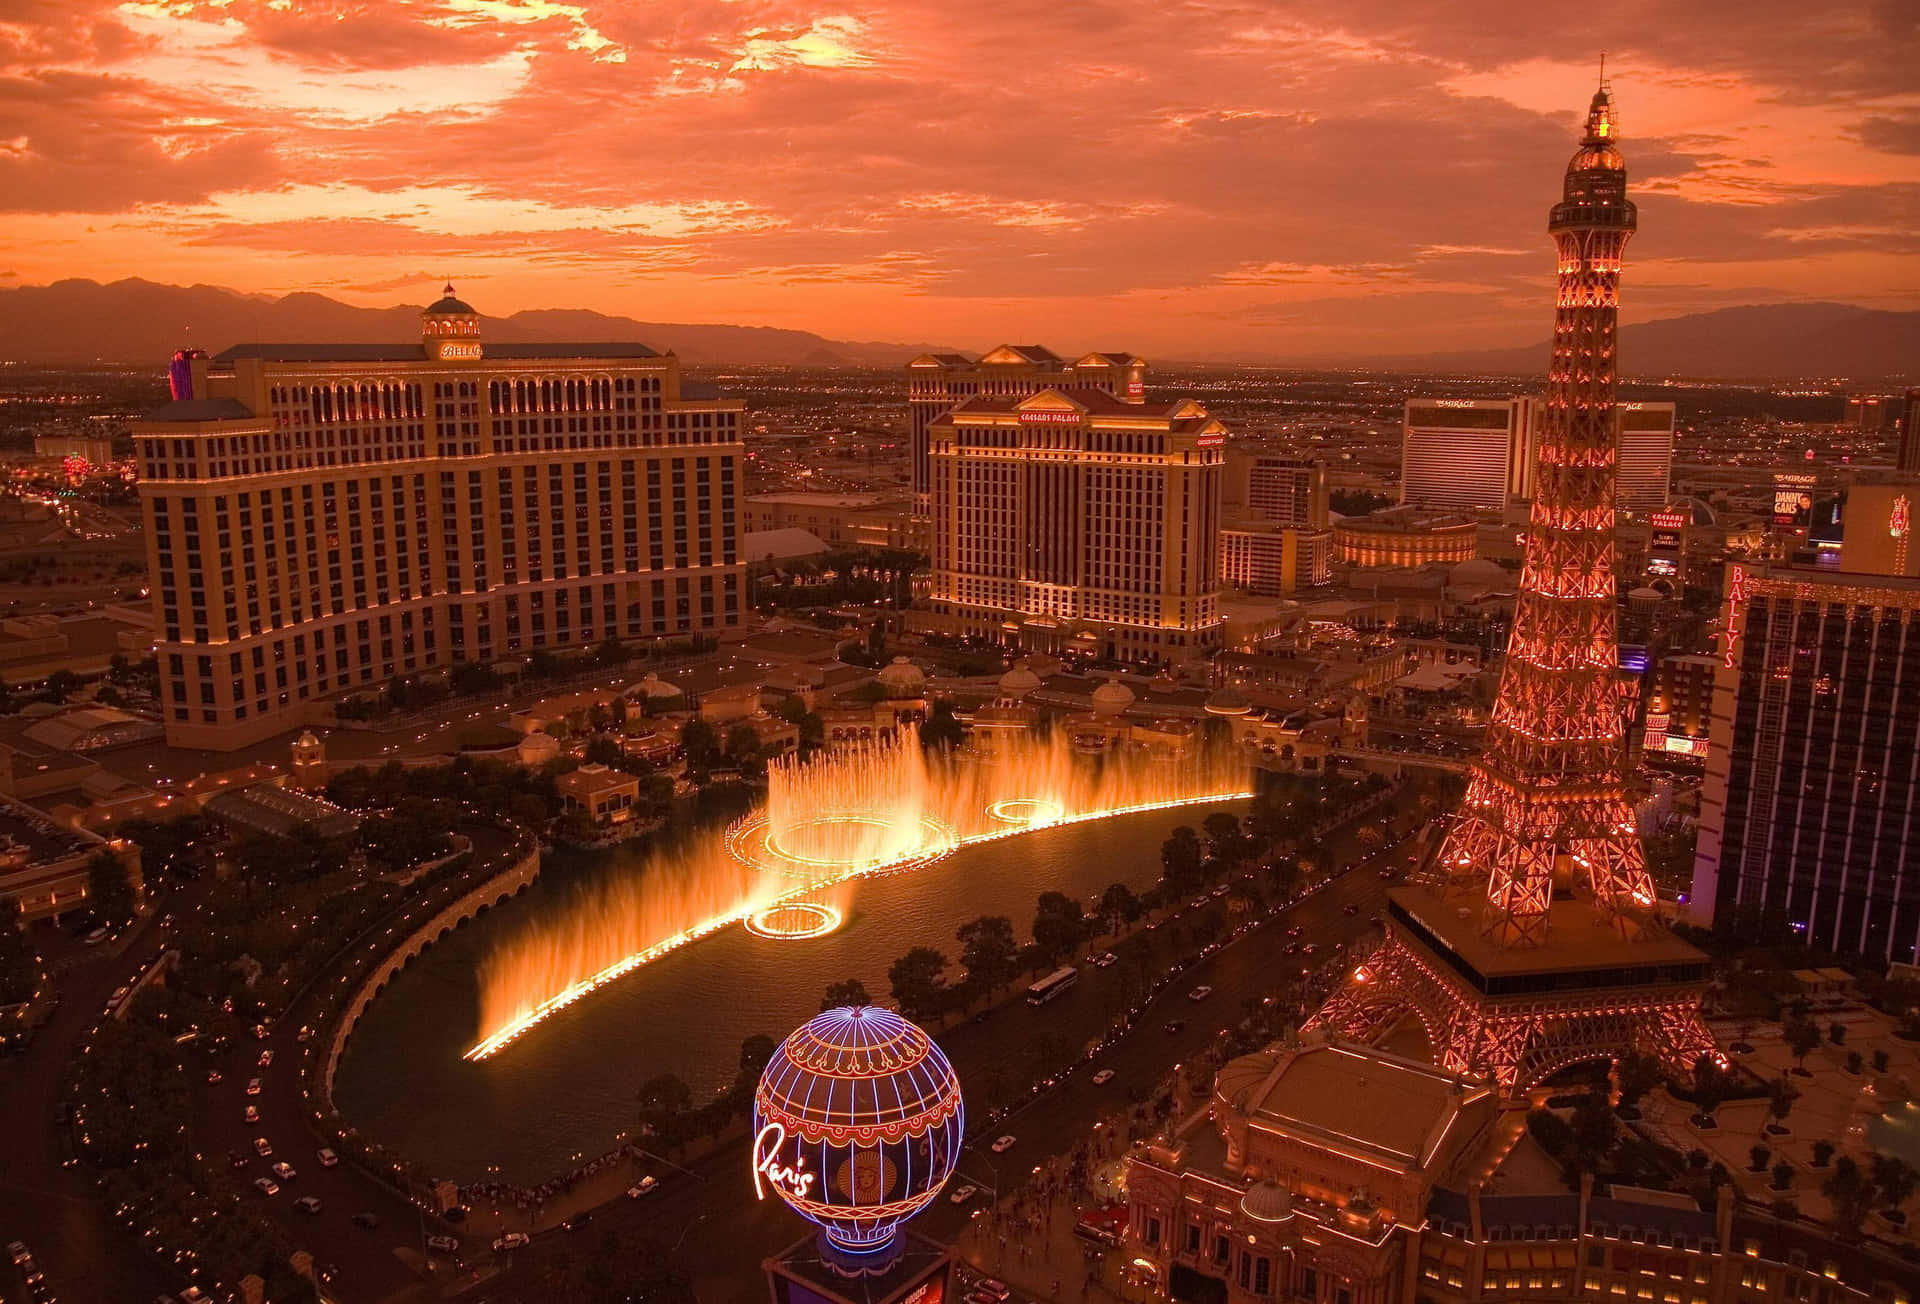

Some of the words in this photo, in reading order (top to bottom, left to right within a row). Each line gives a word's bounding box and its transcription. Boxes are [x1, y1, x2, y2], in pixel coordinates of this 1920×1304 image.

[440, 344, 483, 358] BELLAG
[1445, 399, 1475, 409] MIRAGE
[1625, 401, 1643, 411] AGE
[1021, 413, 1050, 422] CAESARS
[1052, 414, 1080, 423] PALACE
[1775, 492, 1804, 503] DANNY
[1774, 503, 1797, 514] GANS
[753, 1122, 813, 1200] Paris
